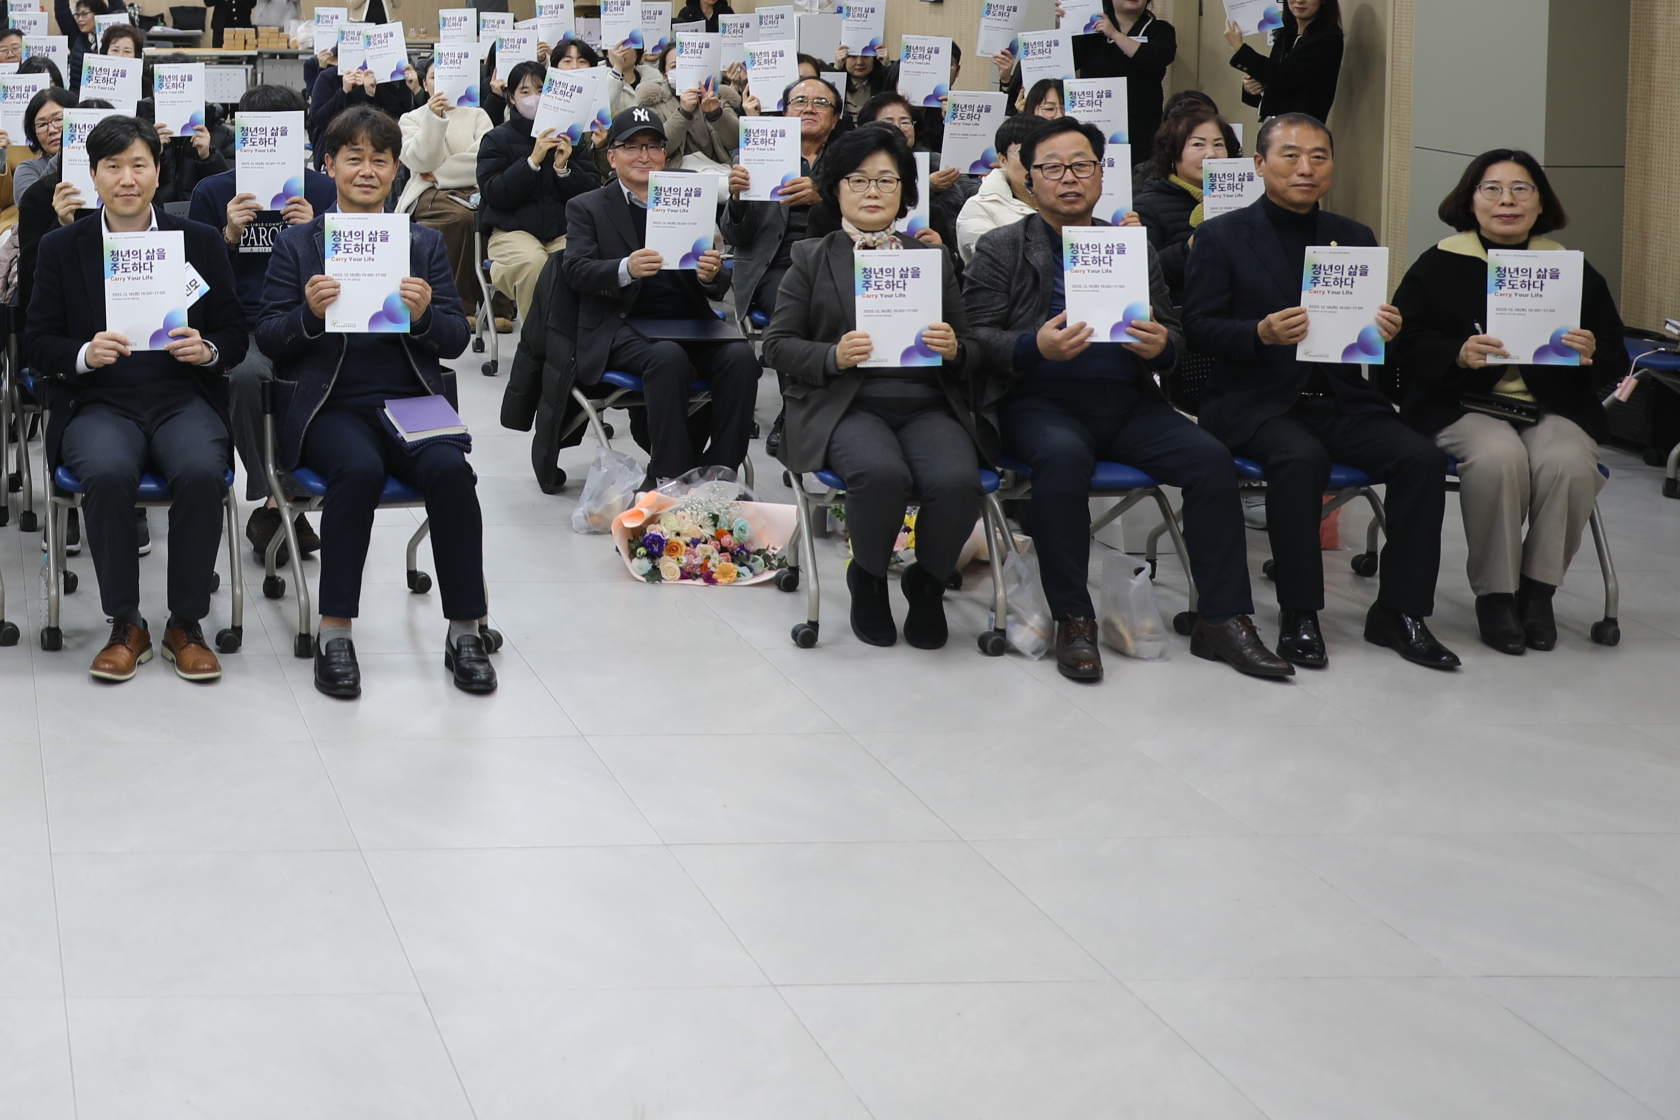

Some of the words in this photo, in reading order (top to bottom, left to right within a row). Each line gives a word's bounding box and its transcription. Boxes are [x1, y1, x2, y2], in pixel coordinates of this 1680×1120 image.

[1022, 40, 1044, 50] 청년의
[1045, 39, 1060, 48] 삶을
[1023, 47, 1052, 57] 주도하다
[158, 74, 178, 83] 청년의
[180, 74, 193, 82] 삶을
[158, 82, 185, 90] 주도하다
[1069, 90, 1094, 100] 청년의
[1096, 90, 1112, 99] 삶을
[951, 103, 975, 113] 청년의
[976, 104, 992, 113] 삶을
[1069, 99, 1103, 109] 주도하다
[950, 112, 982, 122] 주도하다
[240, 126, 267, 137] 청년의
[270, 126, 288, 137] 삶을
[240, 137, 277, 148] 주도하다
[653, 186, 682, 197] 청년의
[684, 187, 703, 198] 삶을
[652, 196, 691, 208] 주도하다
[331, 230, 364, 242] 청년의
[368, 230, 390, 243] 삶을
[109, 249, 142, 262] 청년의
[145, 248, 167, 261] 삶을
[331, 243, 376, 255] 주도하다
[1068, 243, 1102, 255] 청년의
[1104, 243, 1126, 255] 삶을
[1069, 255, 1113, 267] 주도하다
[109, 261, 154, 275] 주도하다
[861, 267, 895, 279] 청년의
[898, 267, 921, 279] 삶을
[1310, 263, 1345, 276] 청년의
[1347, 264, 1370, 277] 삶을
[1494, 266, 1532, 279] 청년의
[1536, 268, 1561, 280] 삶을
[861, 279, 907, 292] 주도하다
[1309, 276, 1355, 289] 주도하다
[1494, 278, 1545, 292] 주도하다
